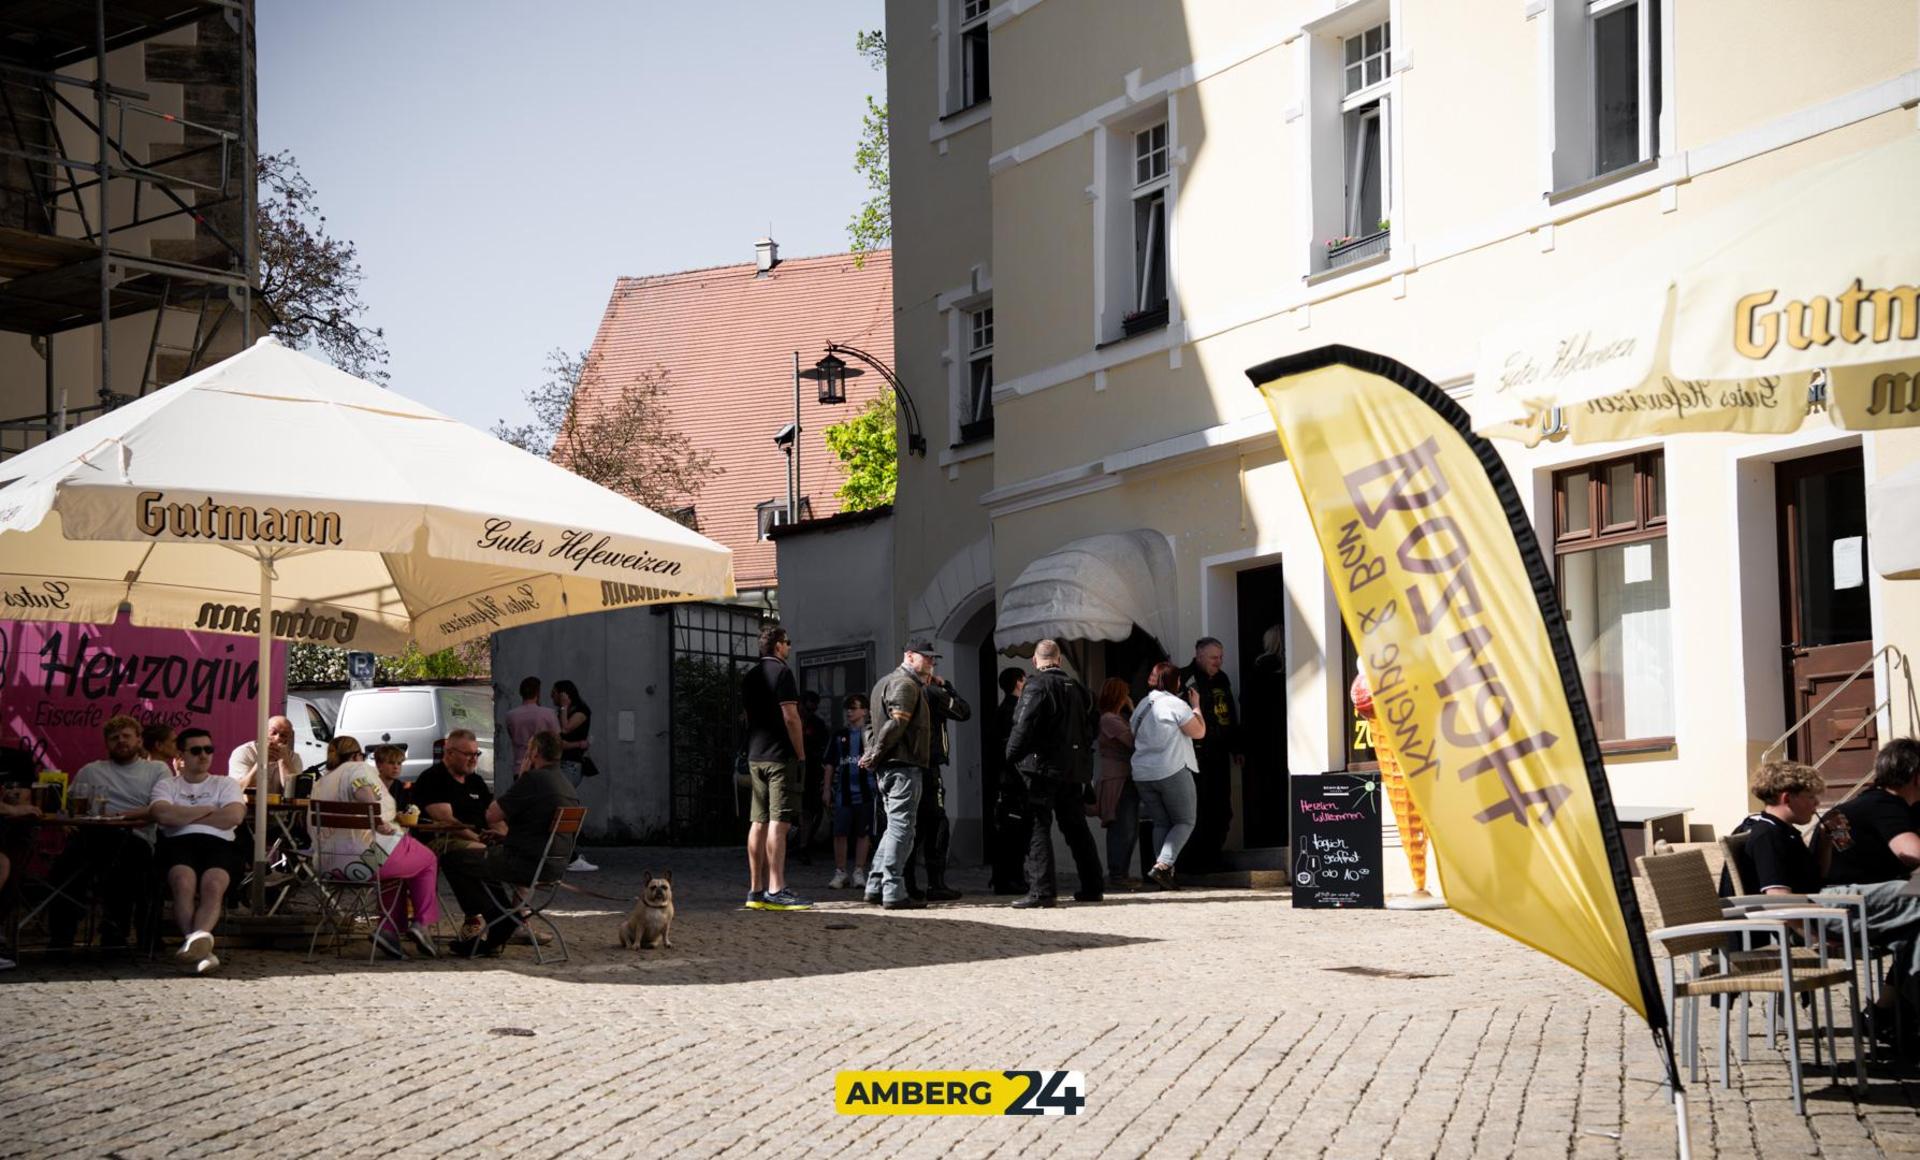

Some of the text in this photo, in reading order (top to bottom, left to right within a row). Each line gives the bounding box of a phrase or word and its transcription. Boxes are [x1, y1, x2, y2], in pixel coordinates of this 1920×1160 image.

[136, 491, 343, 545] Gutmann
[477, 518, 683, 576] Gutes Hefeweizen
[39, 630, 261, 714] Herzogin
